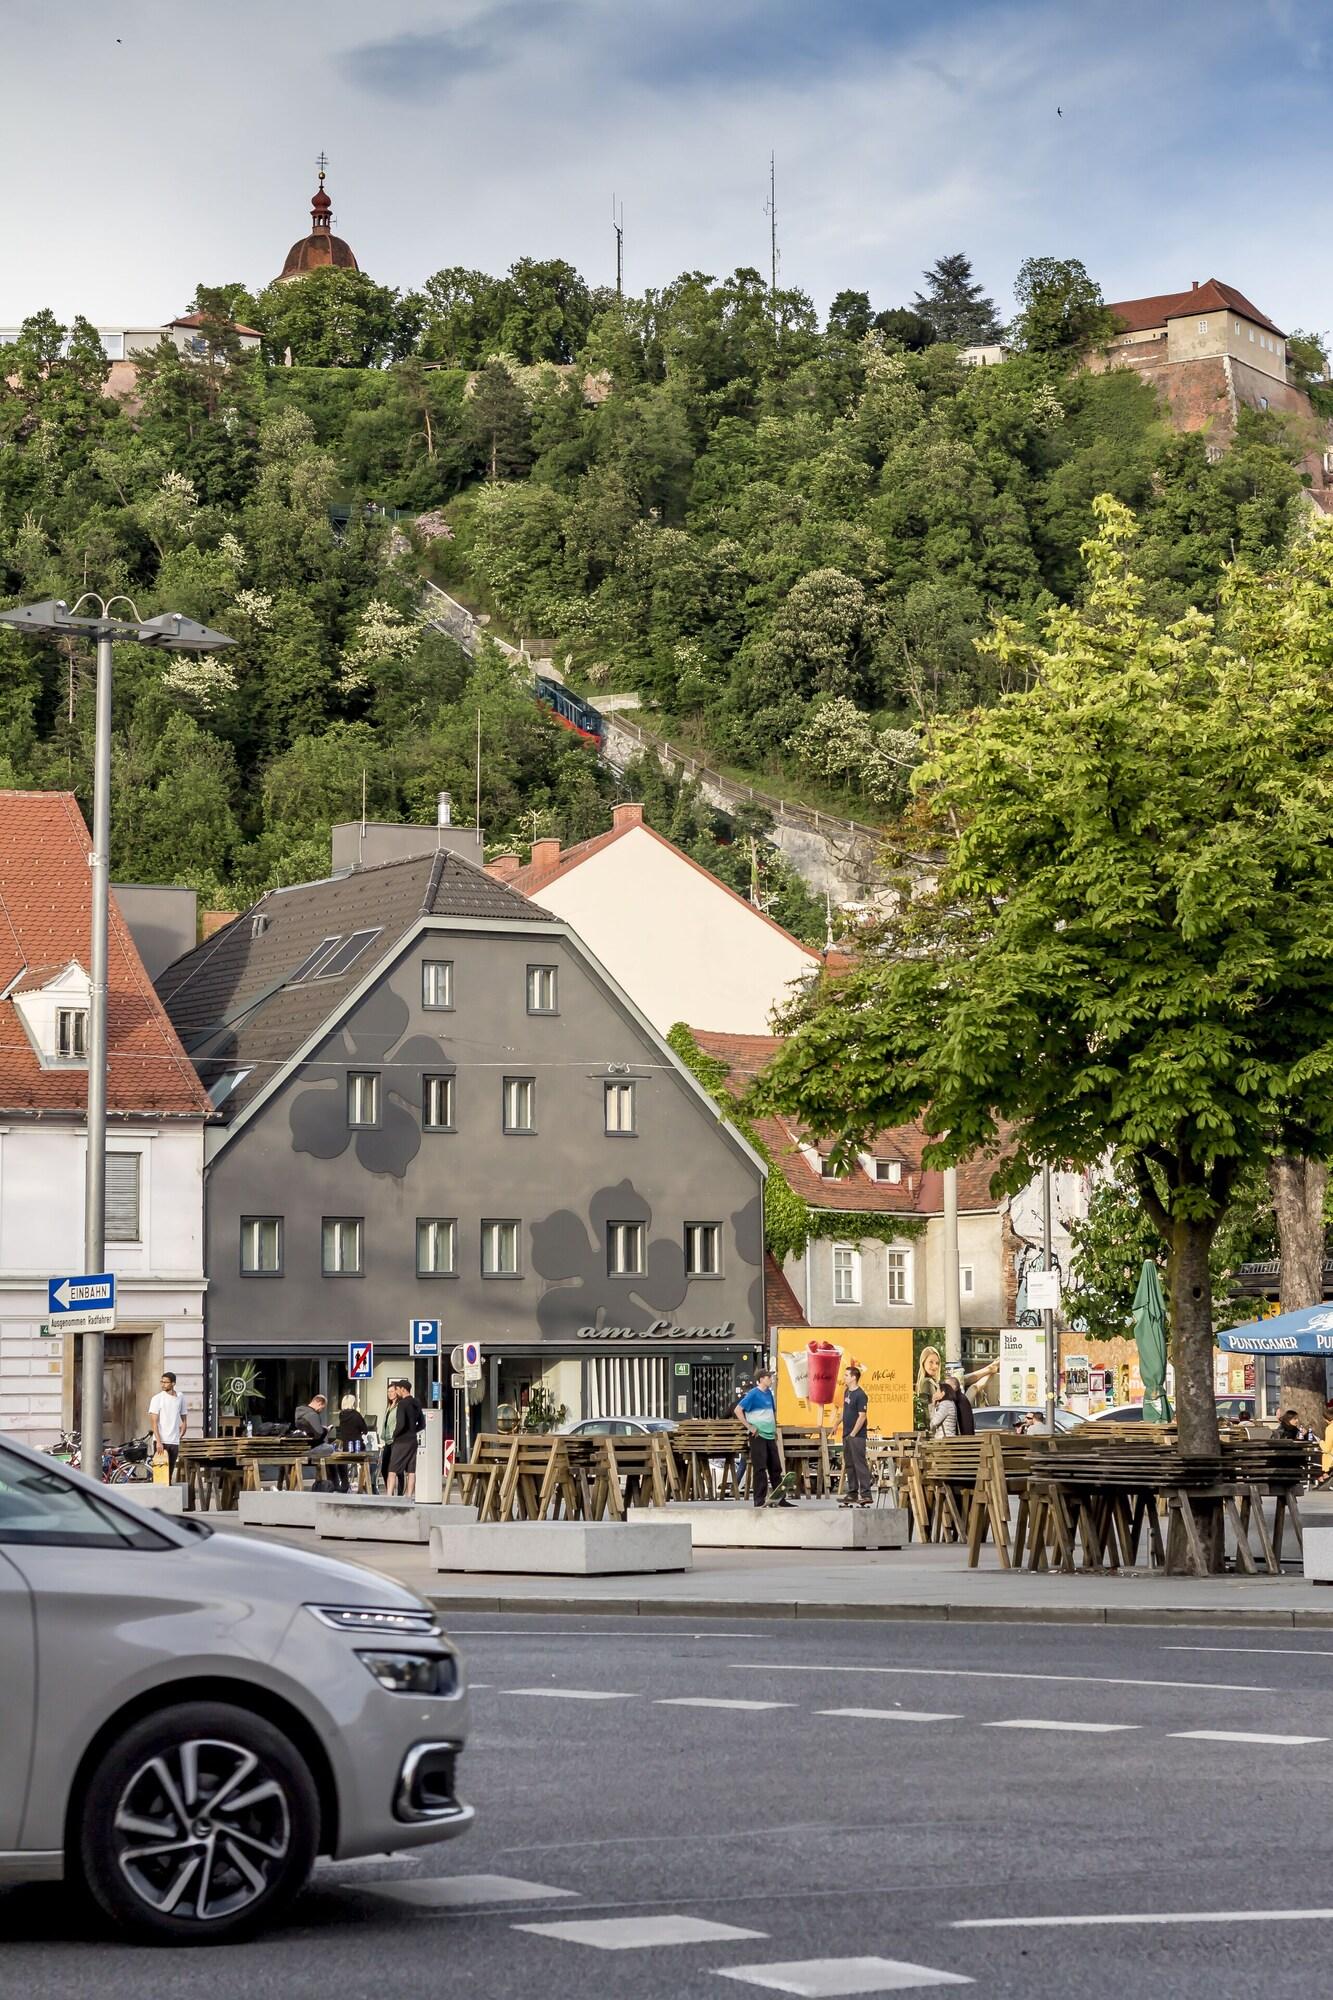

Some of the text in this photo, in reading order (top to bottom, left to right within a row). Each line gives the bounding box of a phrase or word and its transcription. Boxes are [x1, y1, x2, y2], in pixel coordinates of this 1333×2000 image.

[70, 1286, 107, 1300] EINBAHN
[51, 1314, 112, 1329] Ausgenommen Radfahrer
[577, 1319, 735, 1339] am Lend
[418, 1322, 433, 1343] P
[1004, 1335, 1017, 1343] bio
[1228, 1334, 1333, 1350] PUNTIGAMER PU
[872, 1369, 896, 1381] McCafé
